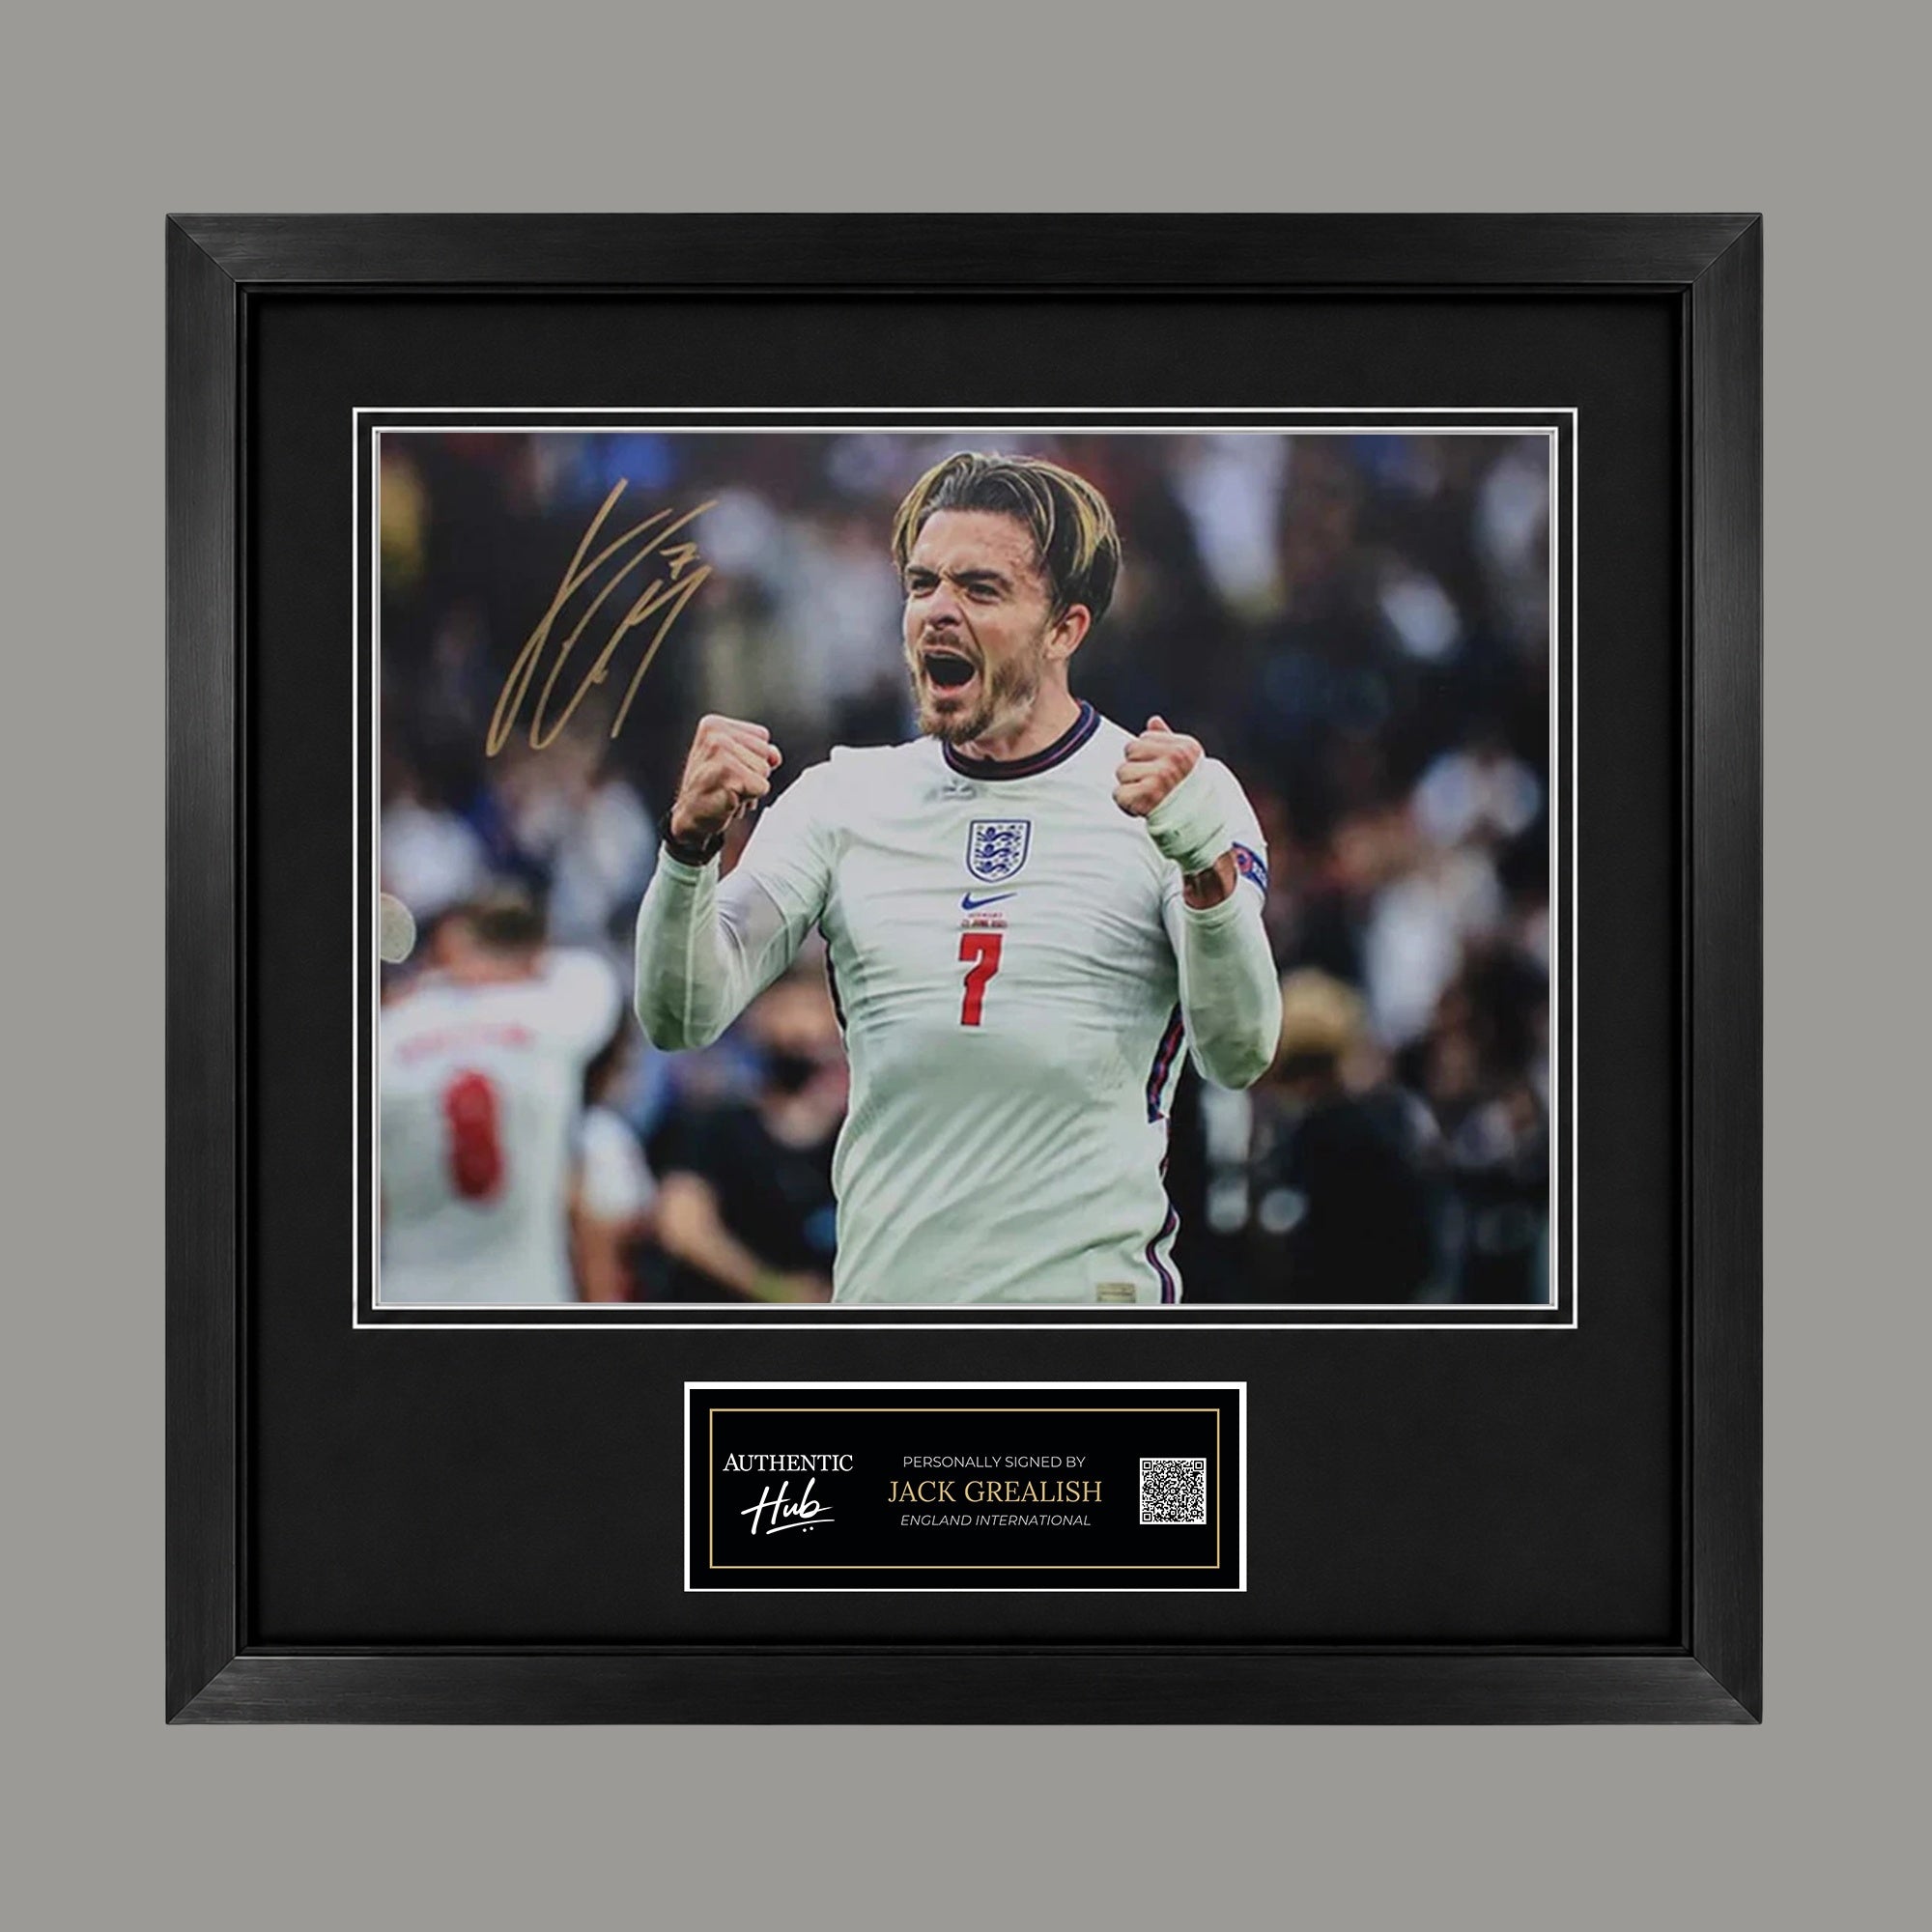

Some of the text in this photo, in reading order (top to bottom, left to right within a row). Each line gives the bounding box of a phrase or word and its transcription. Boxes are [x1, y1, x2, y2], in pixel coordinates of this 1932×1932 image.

[958, 932, 1004, 1028] 7
[722, 1452, 854, 1472] AUTHENTIC
[902, 1456, 1087, 1468] PERSONALLY SIGNED BY
[887, 1480, 1103, 1503] JACK GREALISH
[740, 1476, 835, 1535] Hub
[899, 1514, 1092, 1527] ENGLAND INTERNATIONAL
